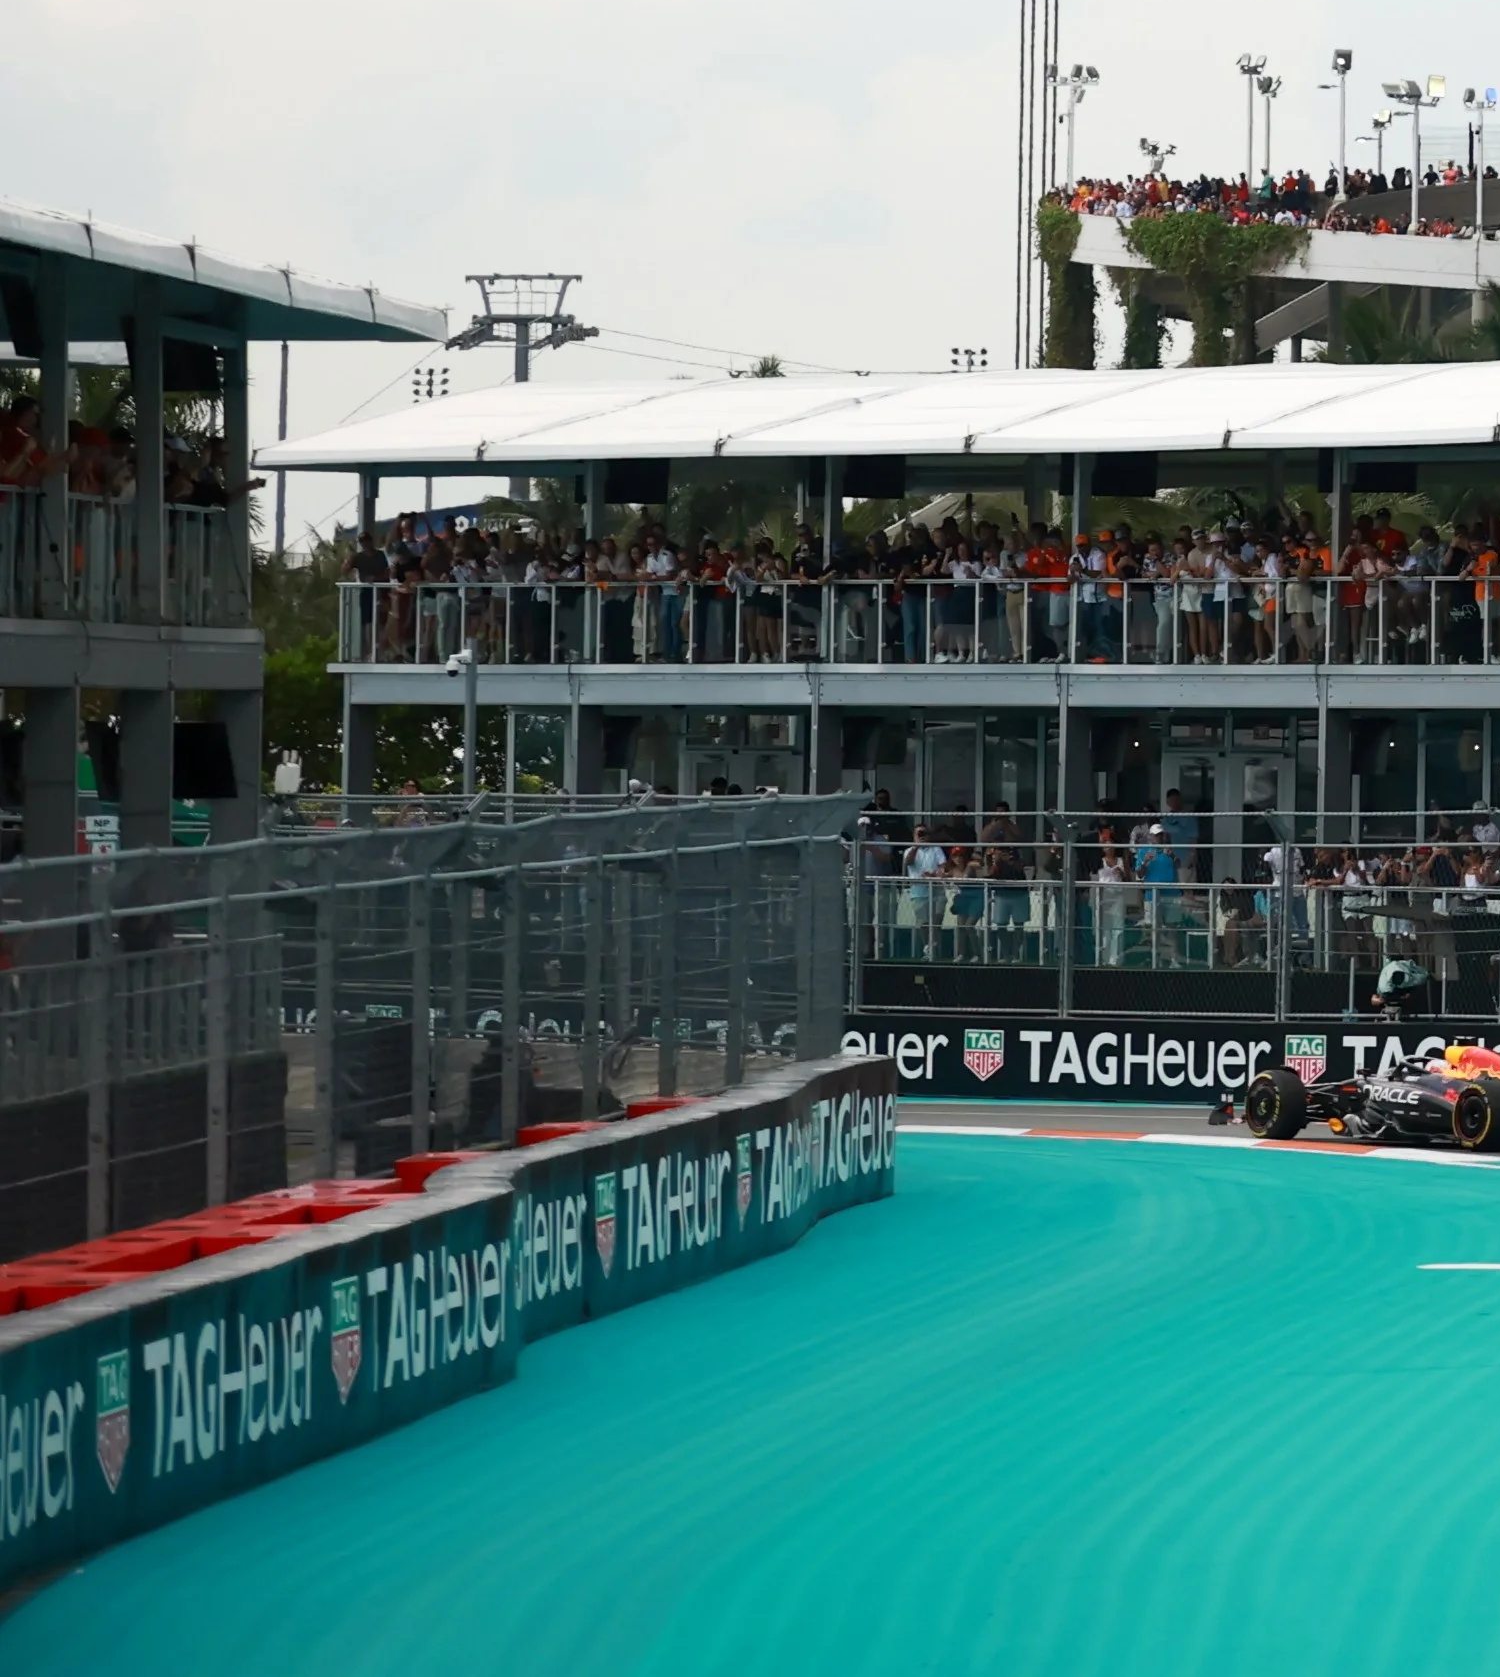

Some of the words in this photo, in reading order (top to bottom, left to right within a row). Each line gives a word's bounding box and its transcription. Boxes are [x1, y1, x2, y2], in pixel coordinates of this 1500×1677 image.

[967, 1033, 1001, 1050] TAG
[1289, 1038, 1323, 1056] TAG
[966, 1053, 1002, 1079] HEUER
[1363, 1083, 1424, 1105] ORACLE
[0, 1380, 85, 1538] euer
